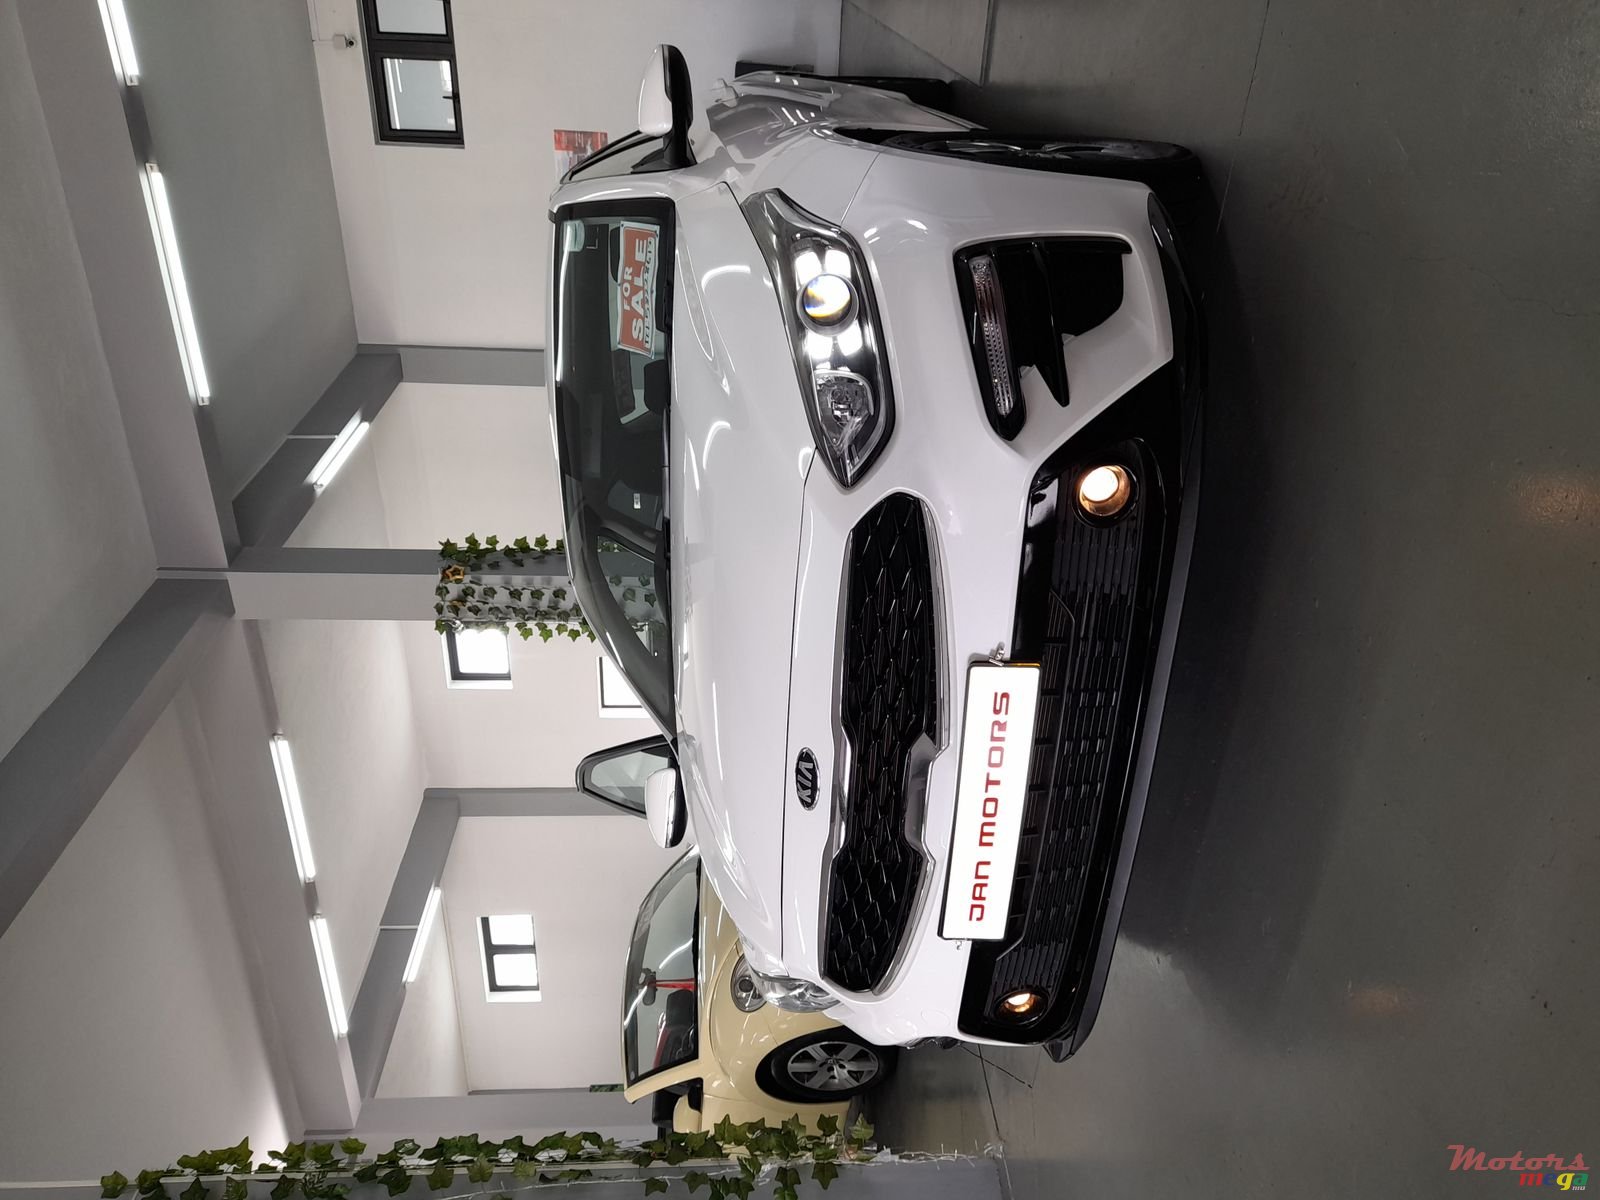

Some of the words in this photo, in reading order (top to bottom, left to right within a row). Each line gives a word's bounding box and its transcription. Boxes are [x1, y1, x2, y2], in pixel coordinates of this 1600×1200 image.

[622, 266, 633, 311] FOR
[631, 238, 647, 341] SALE
[797, 761, 813, 803] KIA
[978, 691, 1010, 847] MOTORS
[968, 860, 991, 921] JAN
